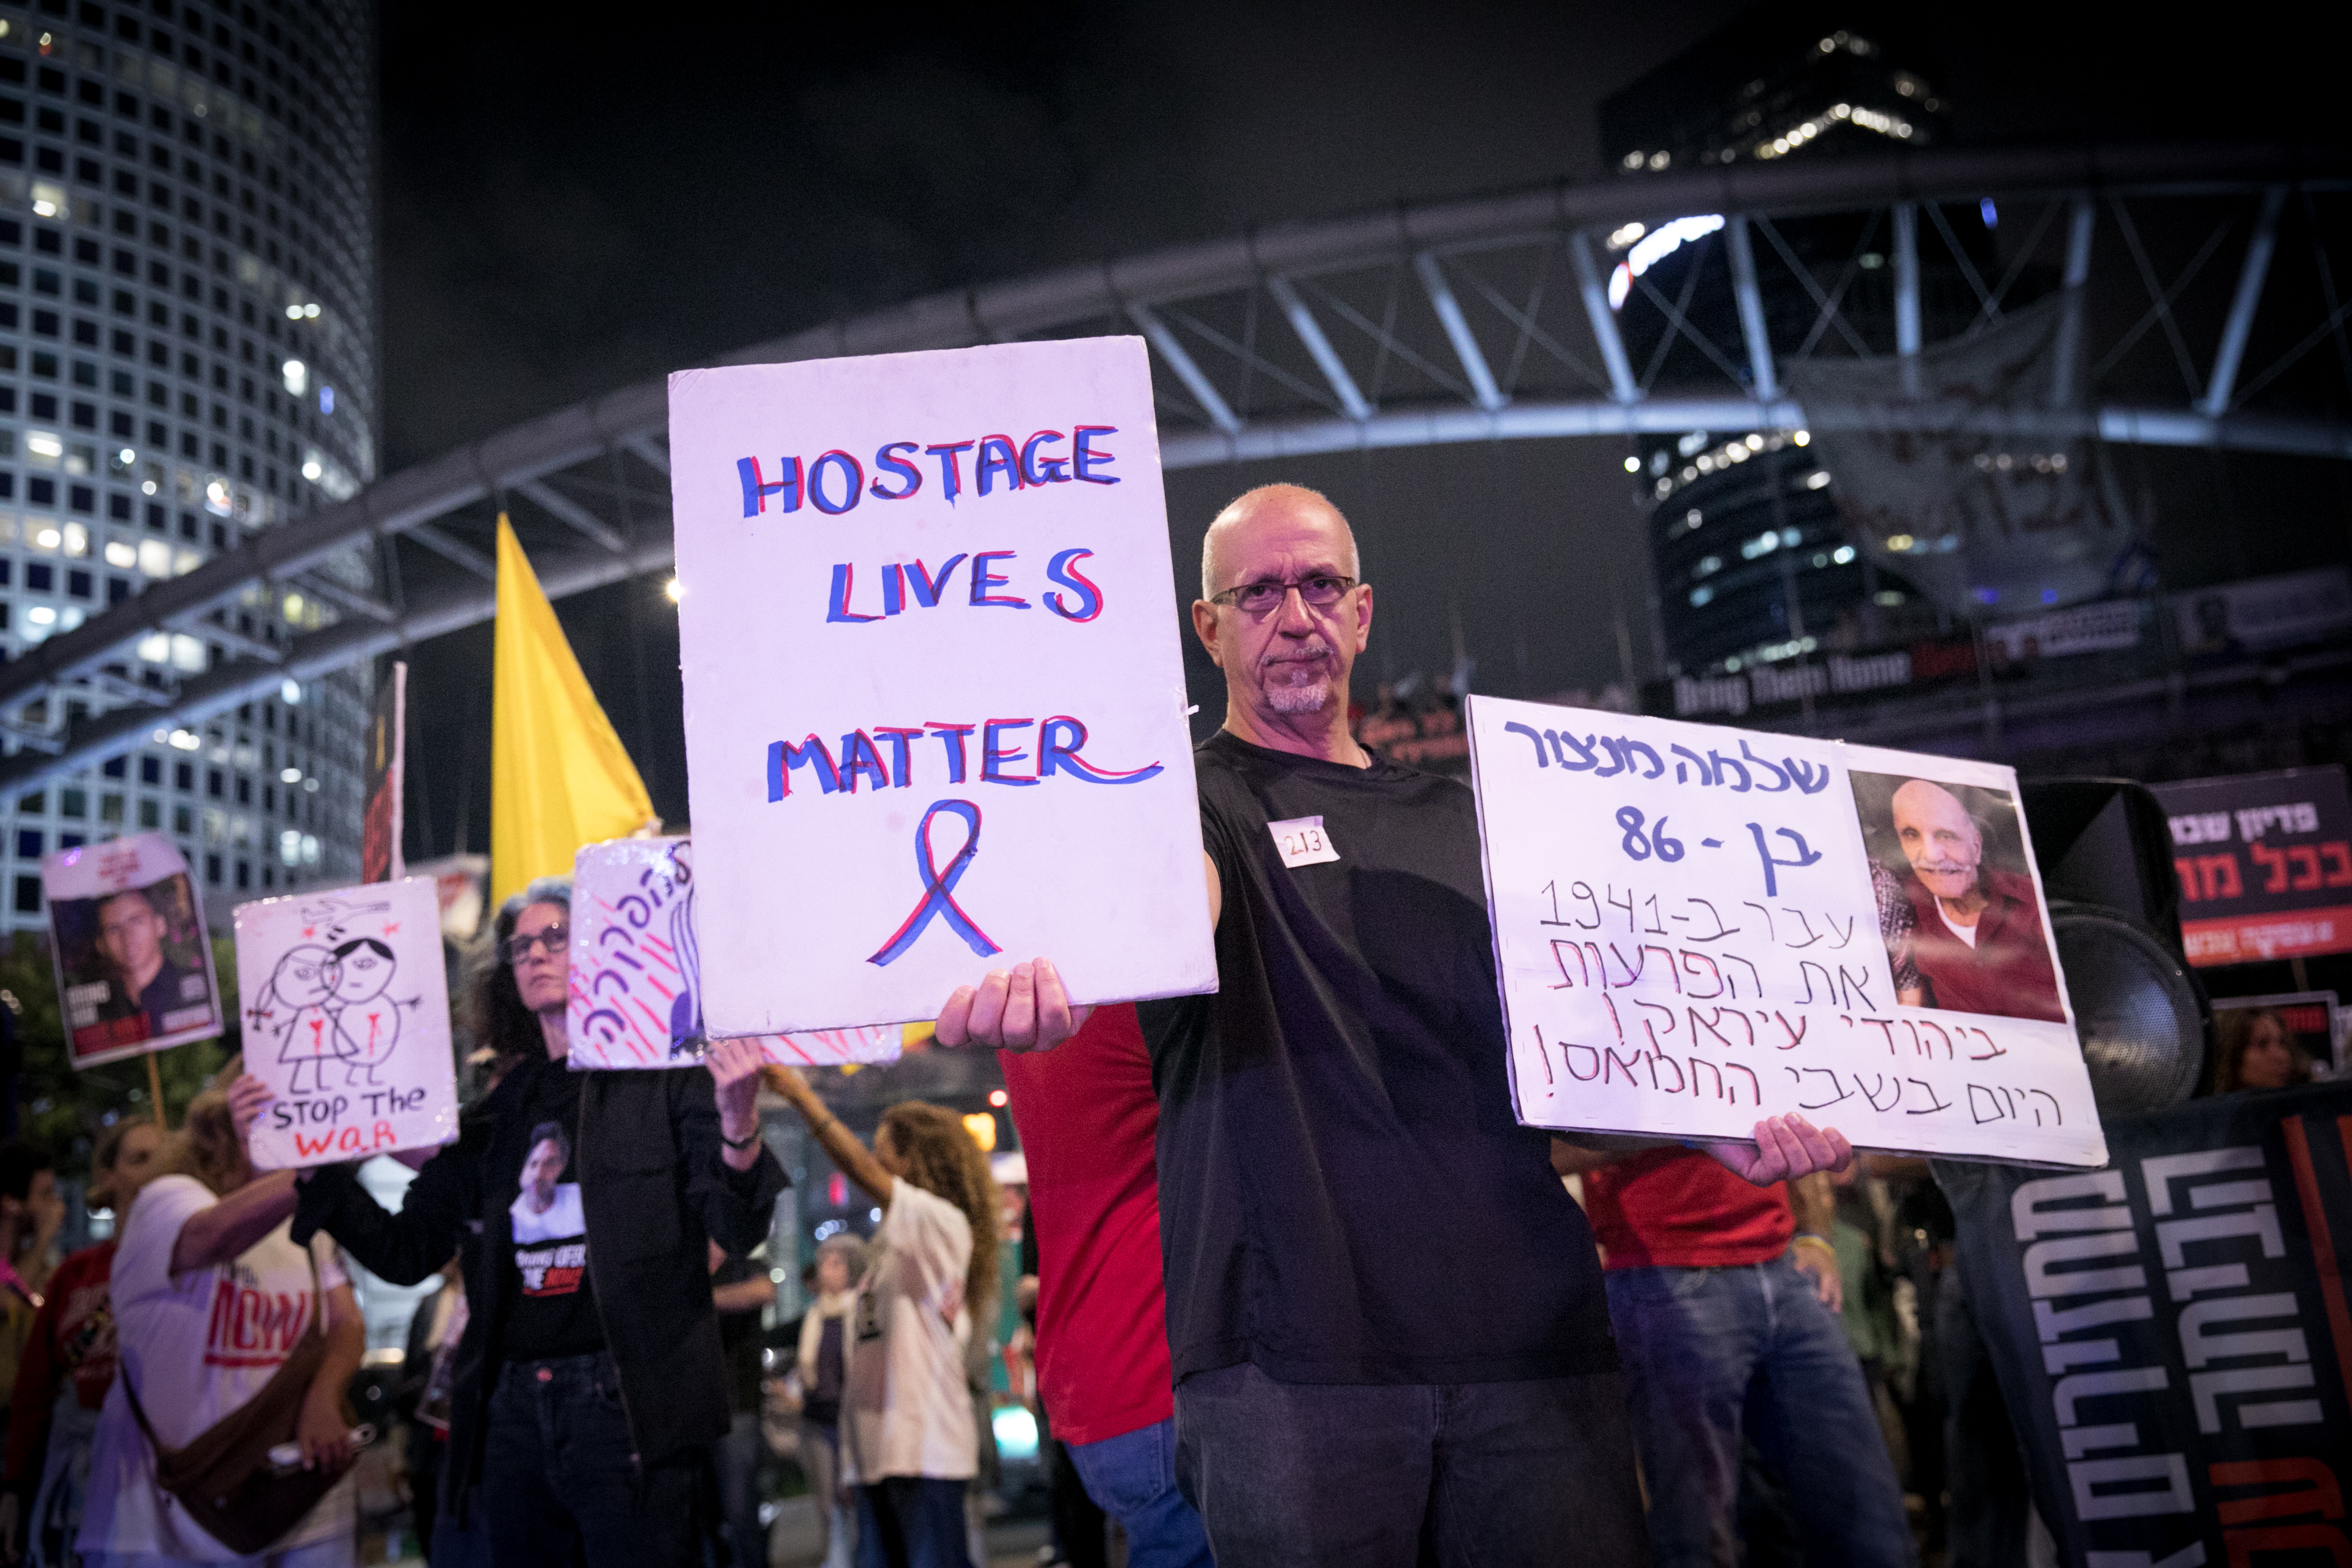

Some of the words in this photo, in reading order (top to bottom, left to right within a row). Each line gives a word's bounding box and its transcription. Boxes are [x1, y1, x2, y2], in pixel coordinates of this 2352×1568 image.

[737, 425, 1121, 518] HOSTAGE
[826, 548, 1104, 623] LIVES
[768, 715, 1165, 803] MATTER
[1504, 721, 1665, 779] מנצור
[1671, 739, 1830, 794] שלמה
[1284, 830, 1322, 855] 213
[1616, 806, 1685, 862] 86
[1745, 822, 1823, 897] בן
[1743, 901, 1854, 949] עבר
[1547, 939, 1763, 999] הפרעות
[1794, 961, 1876, 1012] את
[1840, 1014, 2006, 1061] ביהודי
[273, 1094, 349, 1130] STOP
[1785, 1067, 1952, 1113] בשבי
[1967, 1083, 2062, 1127] היום
[2141, 1144, 2324, 1435] הביתה
[2010, 1170, 2196, 1522] מחזירים
